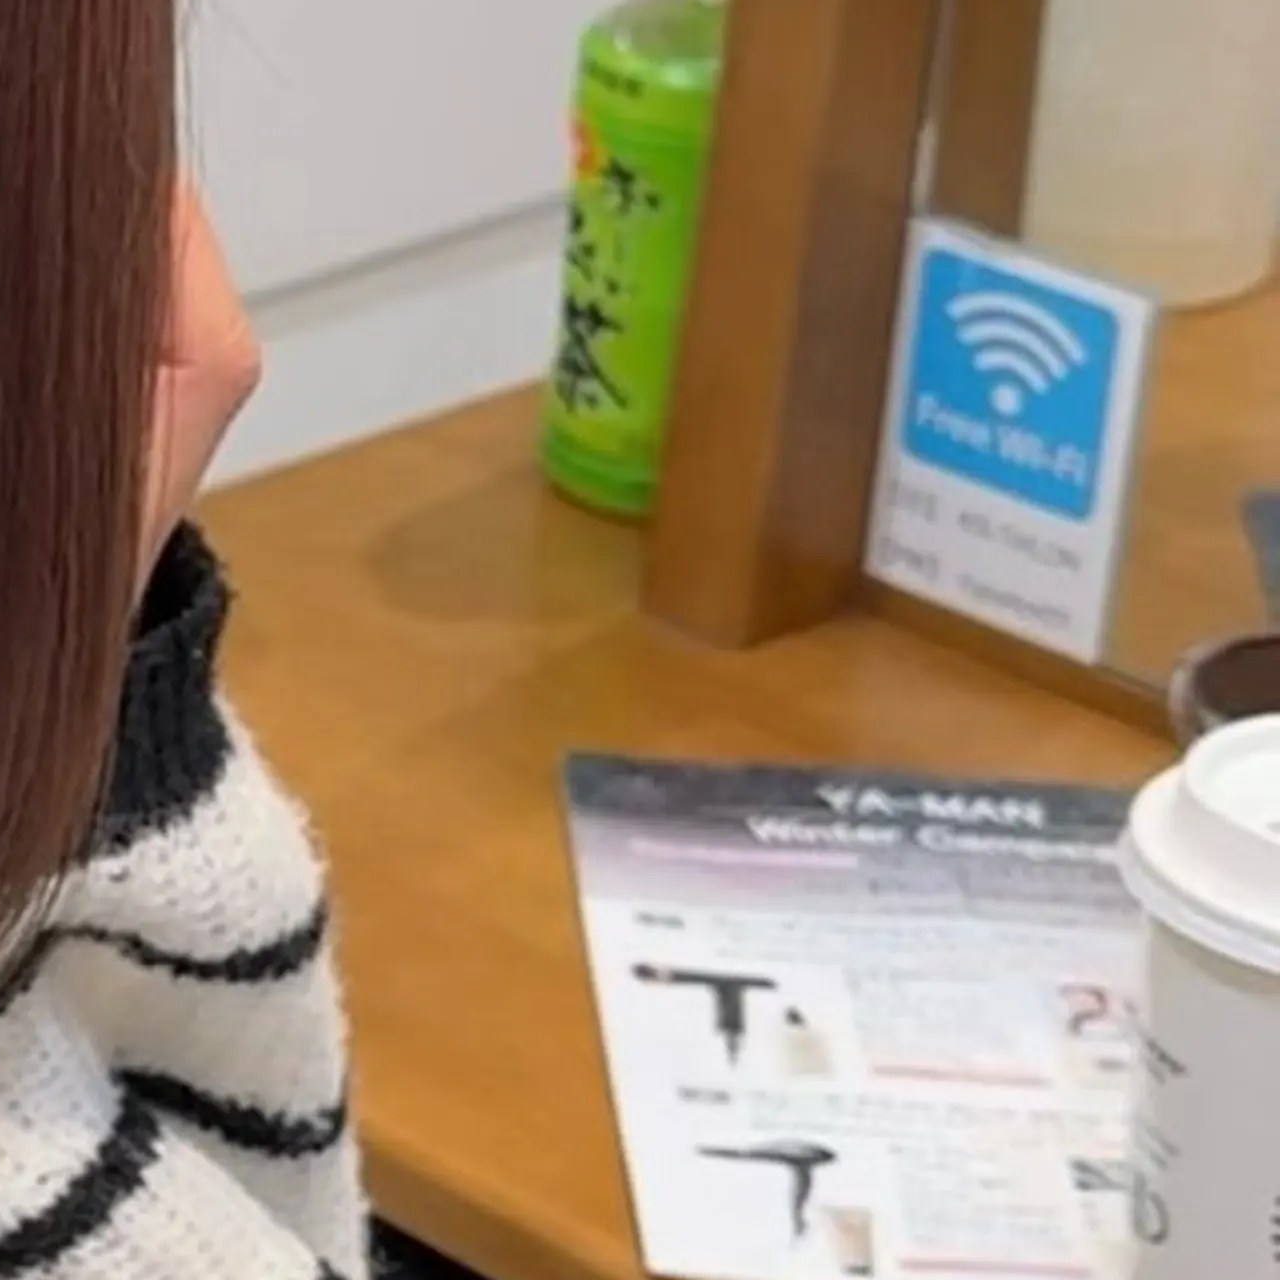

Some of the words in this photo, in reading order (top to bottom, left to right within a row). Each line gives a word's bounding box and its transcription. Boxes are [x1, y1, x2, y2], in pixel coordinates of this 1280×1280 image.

[915, 393, 990, 454] Free
[814, 783, 1044, 829] YA-MAN
[744, 816, 902, 848] Winter
